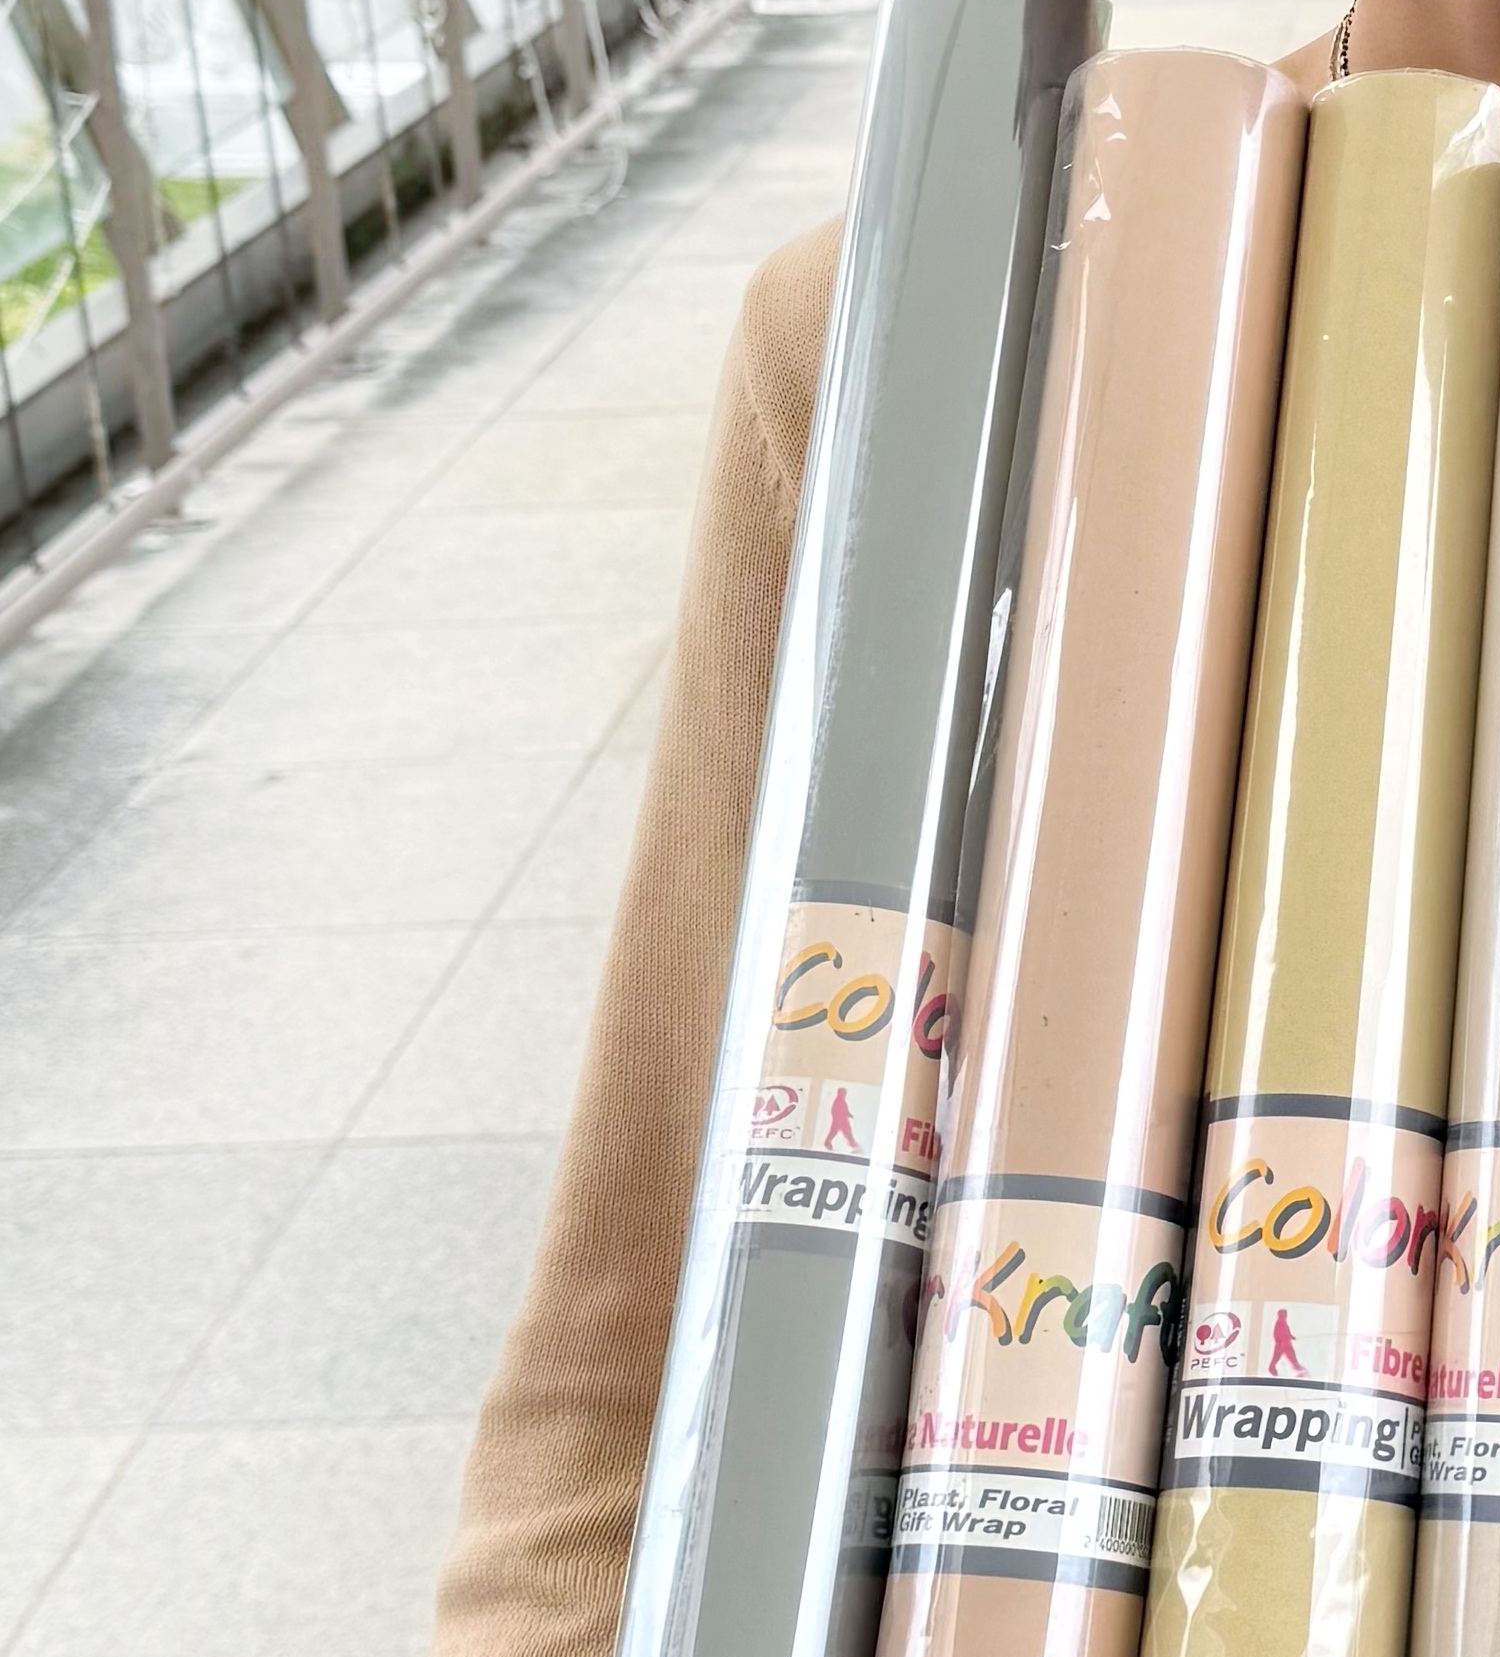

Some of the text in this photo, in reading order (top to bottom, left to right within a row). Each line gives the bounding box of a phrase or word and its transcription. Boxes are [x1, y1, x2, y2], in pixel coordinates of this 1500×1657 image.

[773, 941, 953, 1060] Colo
[748, 1126, 794, 1141] EFC
[1190, 1355, 1238, 1370] PEFC
[1351, 1332, 1422, 1384] Fibre
[919, 1412, 1089, 1459] Naturelle
[1182, 1393, 1400, 1463] Wrapping
[1430, 1461, 1487, 1486] Wrap
[901, 1487, 1079, 1517] Plant, Floral
[900, 1510, 934, 1533] Gift
[942, 1512, 1027, 1541] Wrap
